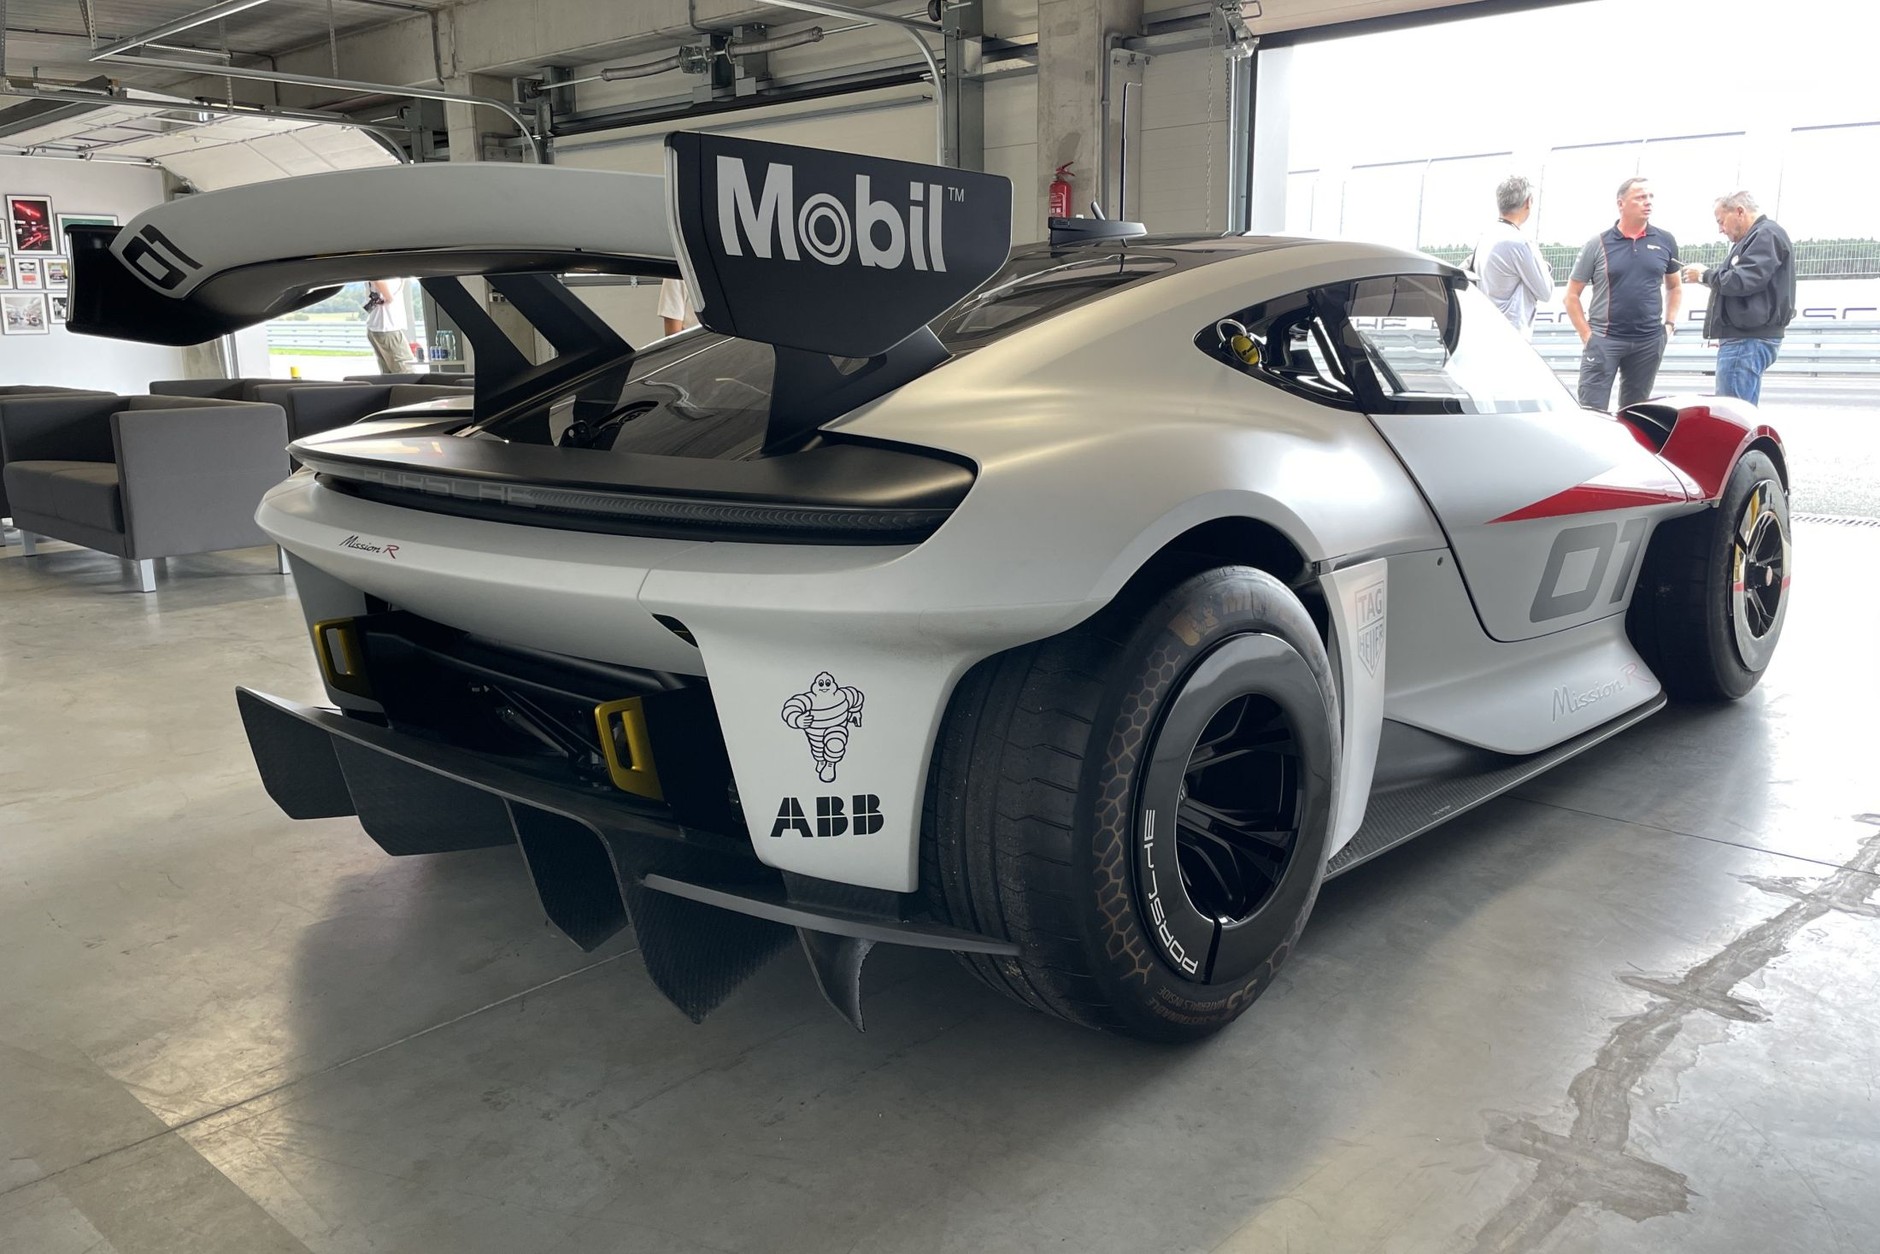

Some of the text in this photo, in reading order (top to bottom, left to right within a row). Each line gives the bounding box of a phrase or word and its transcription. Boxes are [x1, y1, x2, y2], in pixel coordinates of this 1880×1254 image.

[717, 155, 947, 272] Mobil
[339, 535, 400, 559] Mission R
[1529, 517, 1648, 623] 01
[1357, 588, 1382, 623] TAG
[1360, 625, 1384, 671] HEUER
[1552, 662, 1650, 722] Mission R
[770, 794, 885, 838] ABB
[1144, 810, 1198, 975] PORSCHE
